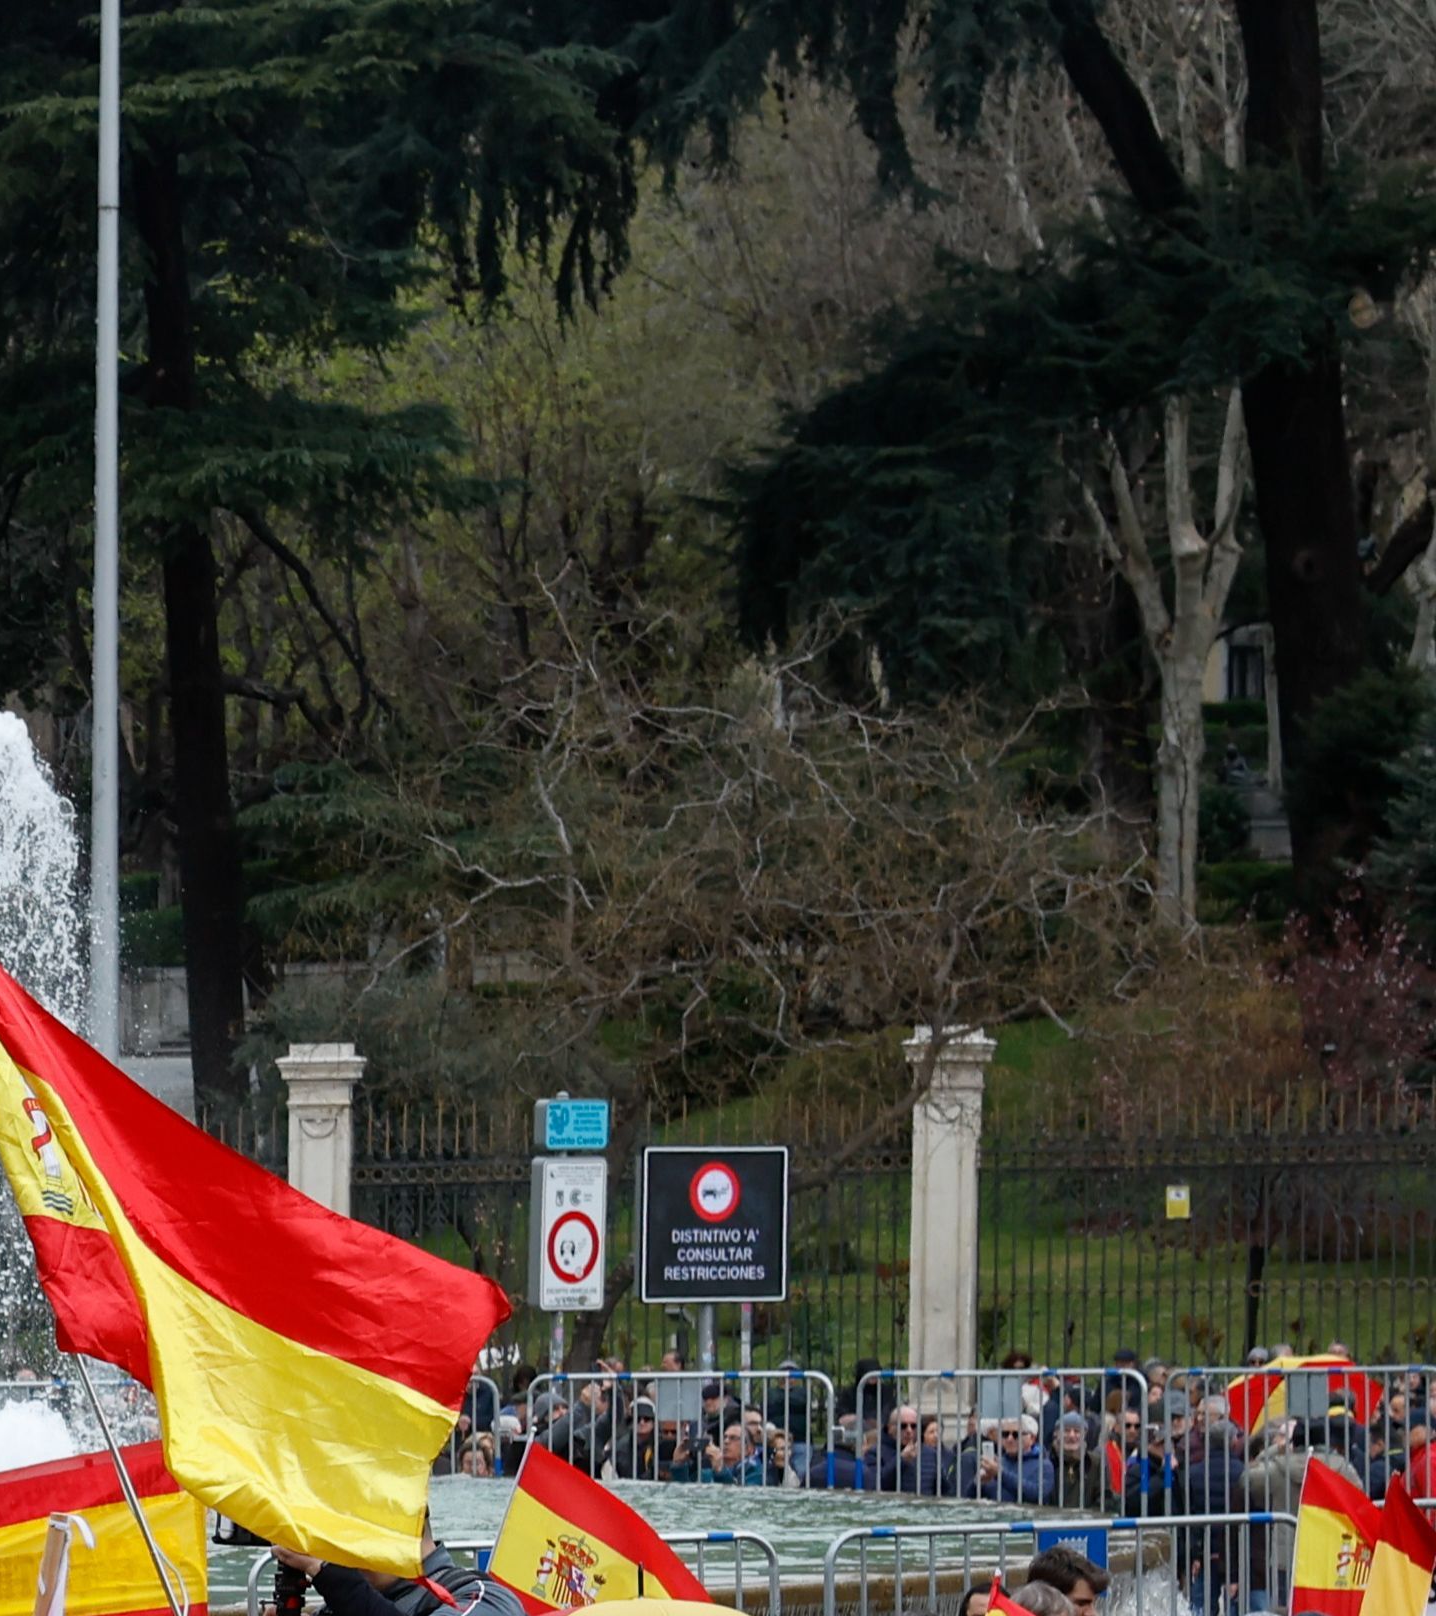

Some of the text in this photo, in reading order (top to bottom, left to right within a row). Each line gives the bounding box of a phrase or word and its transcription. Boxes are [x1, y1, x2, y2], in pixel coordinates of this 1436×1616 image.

[672, 1229, 740, 1243] DISTINTIVO
[677, 1247, 753, 1262] CONSULTAR
[664, 1266, 765, 1280] RESTRICCIONES
